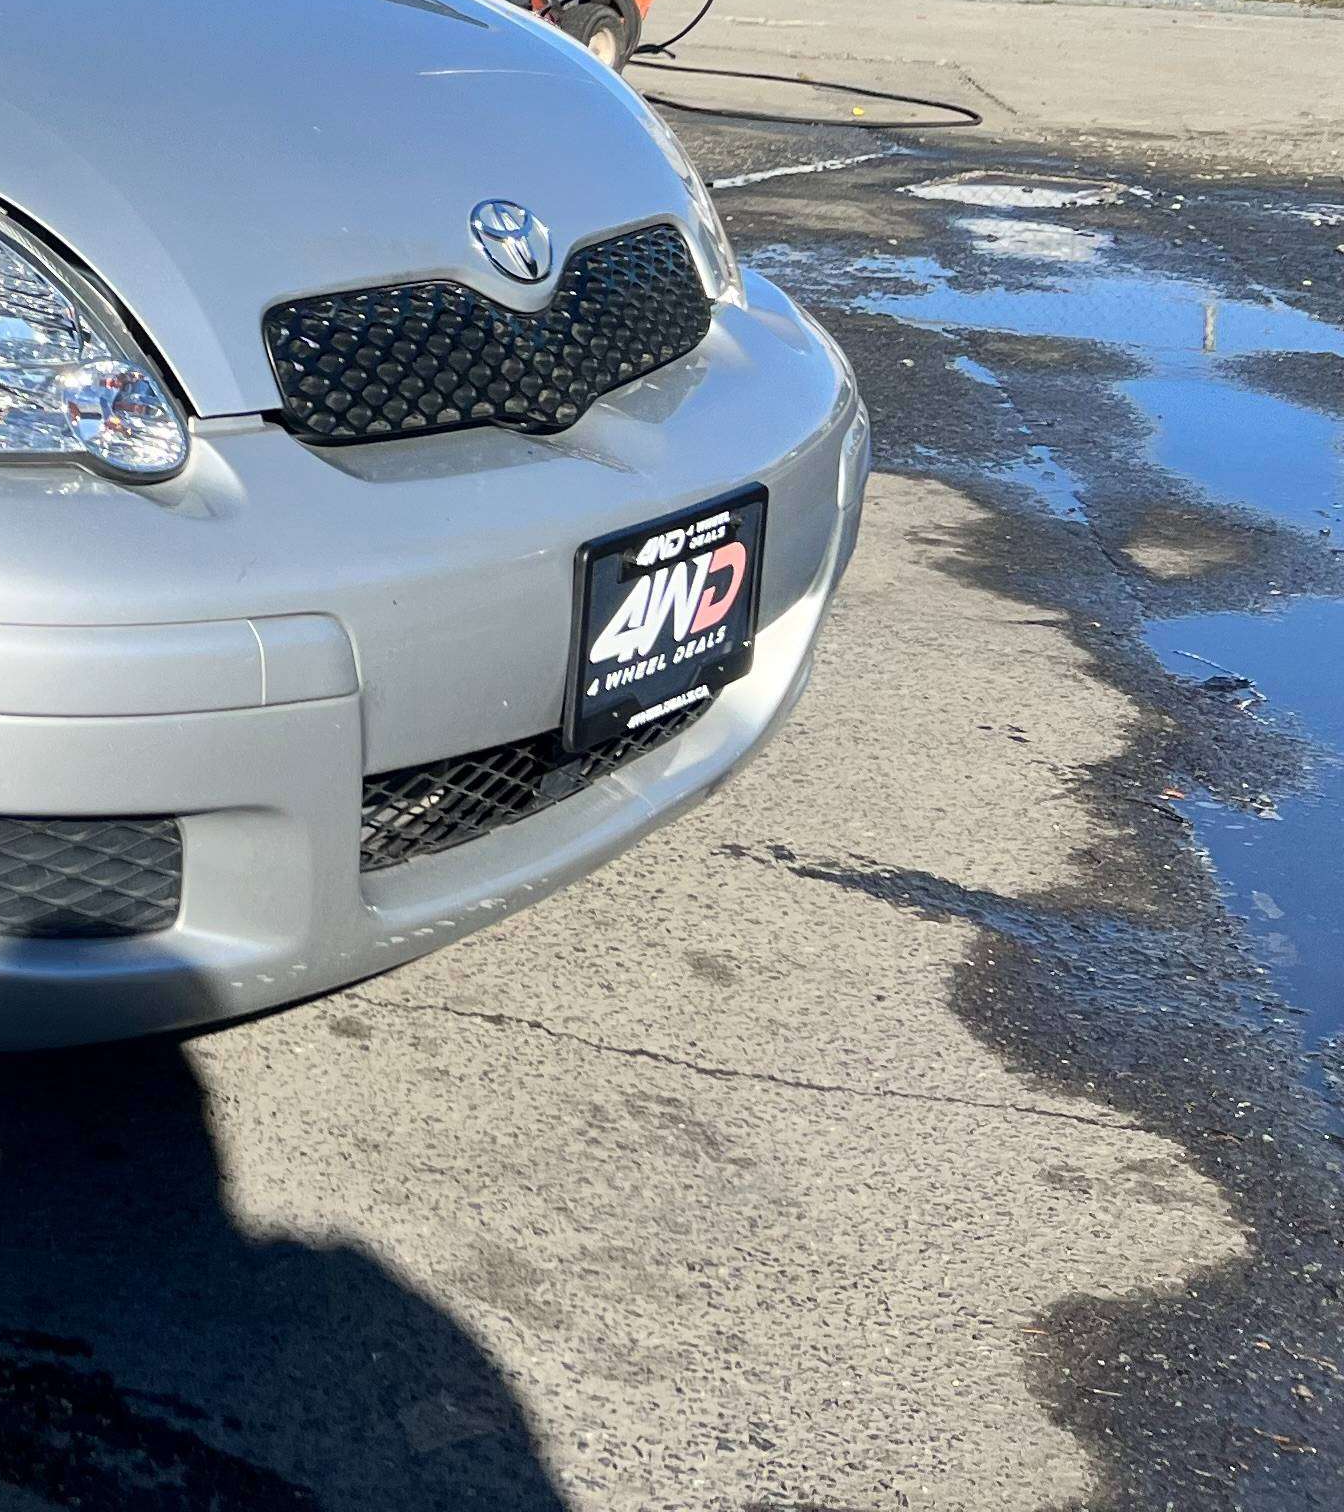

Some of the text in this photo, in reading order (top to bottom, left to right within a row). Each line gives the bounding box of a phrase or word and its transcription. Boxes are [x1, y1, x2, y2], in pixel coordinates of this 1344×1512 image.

[586, 624, 727, 697] 4 WHEEL DEALS
